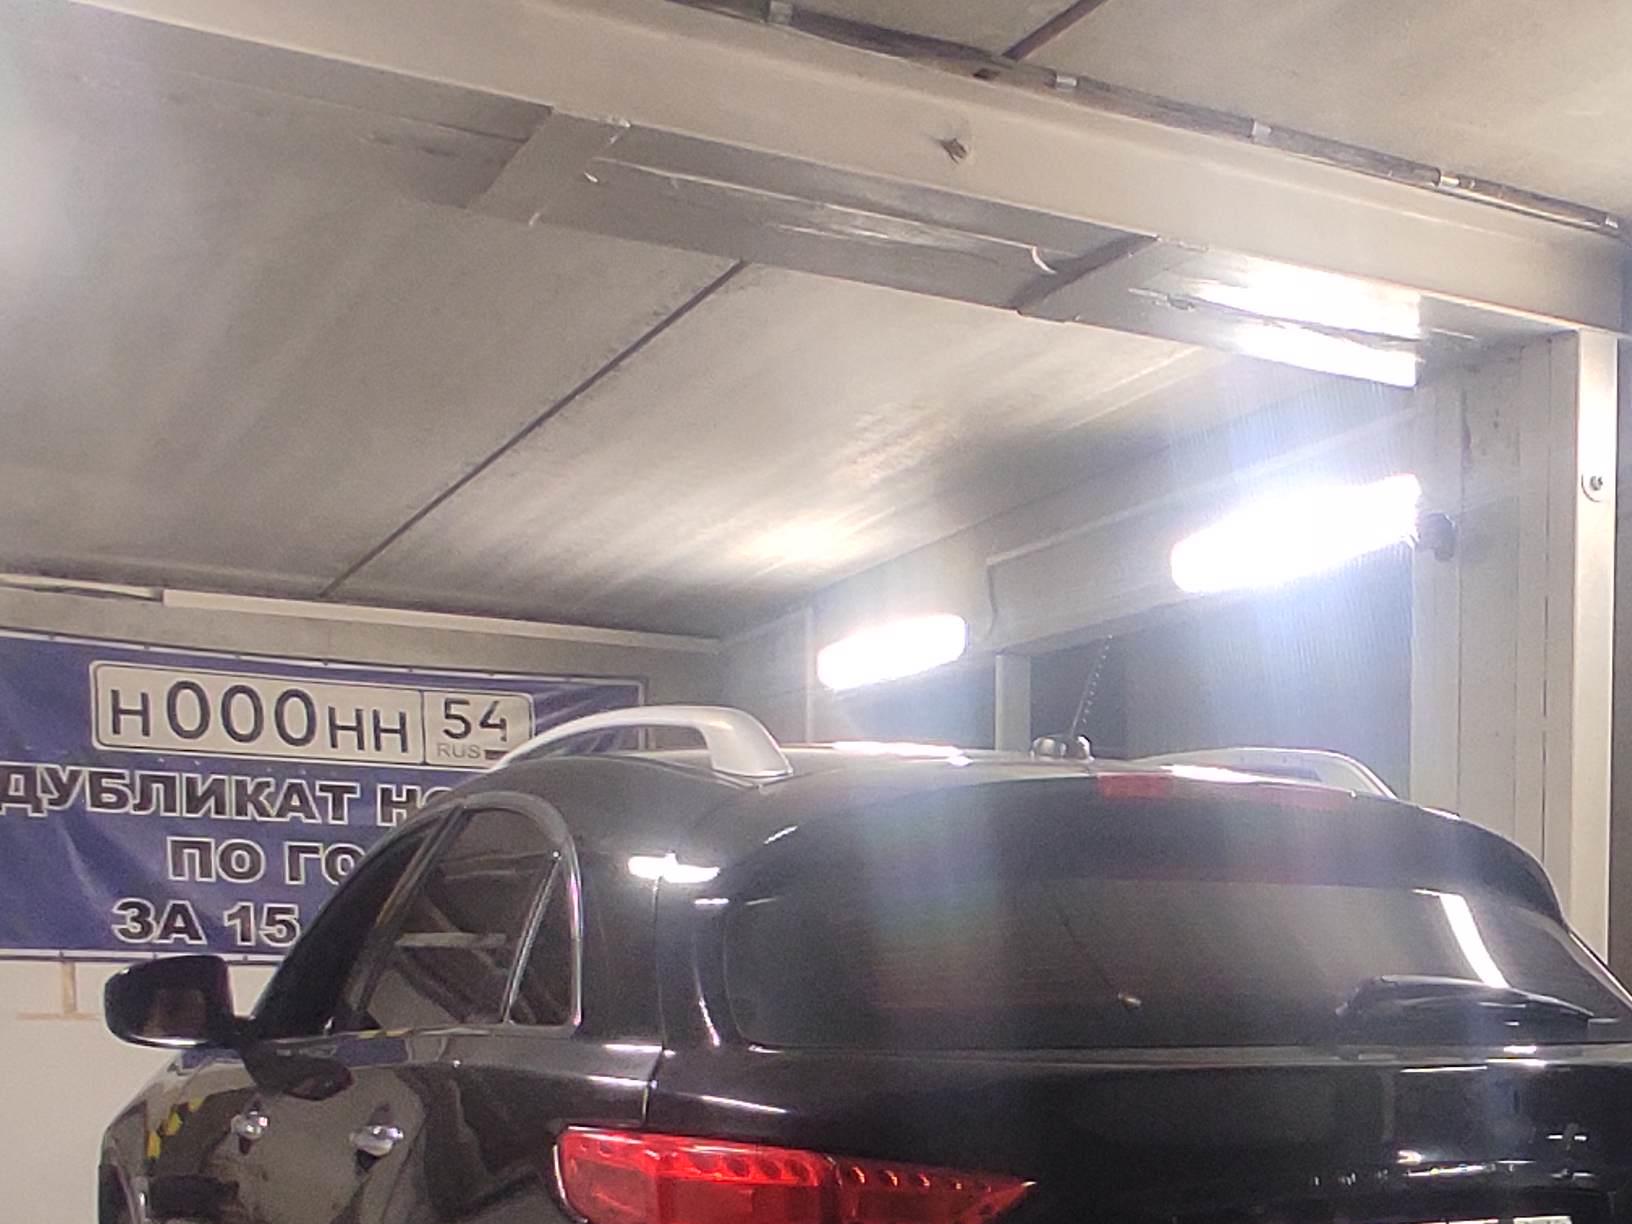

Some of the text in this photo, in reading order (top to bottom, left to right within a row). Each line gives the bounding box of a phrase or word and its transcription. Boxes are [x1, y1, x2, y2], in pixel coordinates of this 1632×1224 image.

[442, 696, 509, 743] 54
[436, 742, 481, 760] RUS
[0, 761, 360, 825] ДУБЛИКАТ
[166, 836, 266, 883] ПО
[111, 897, 206, 945] ЗА
